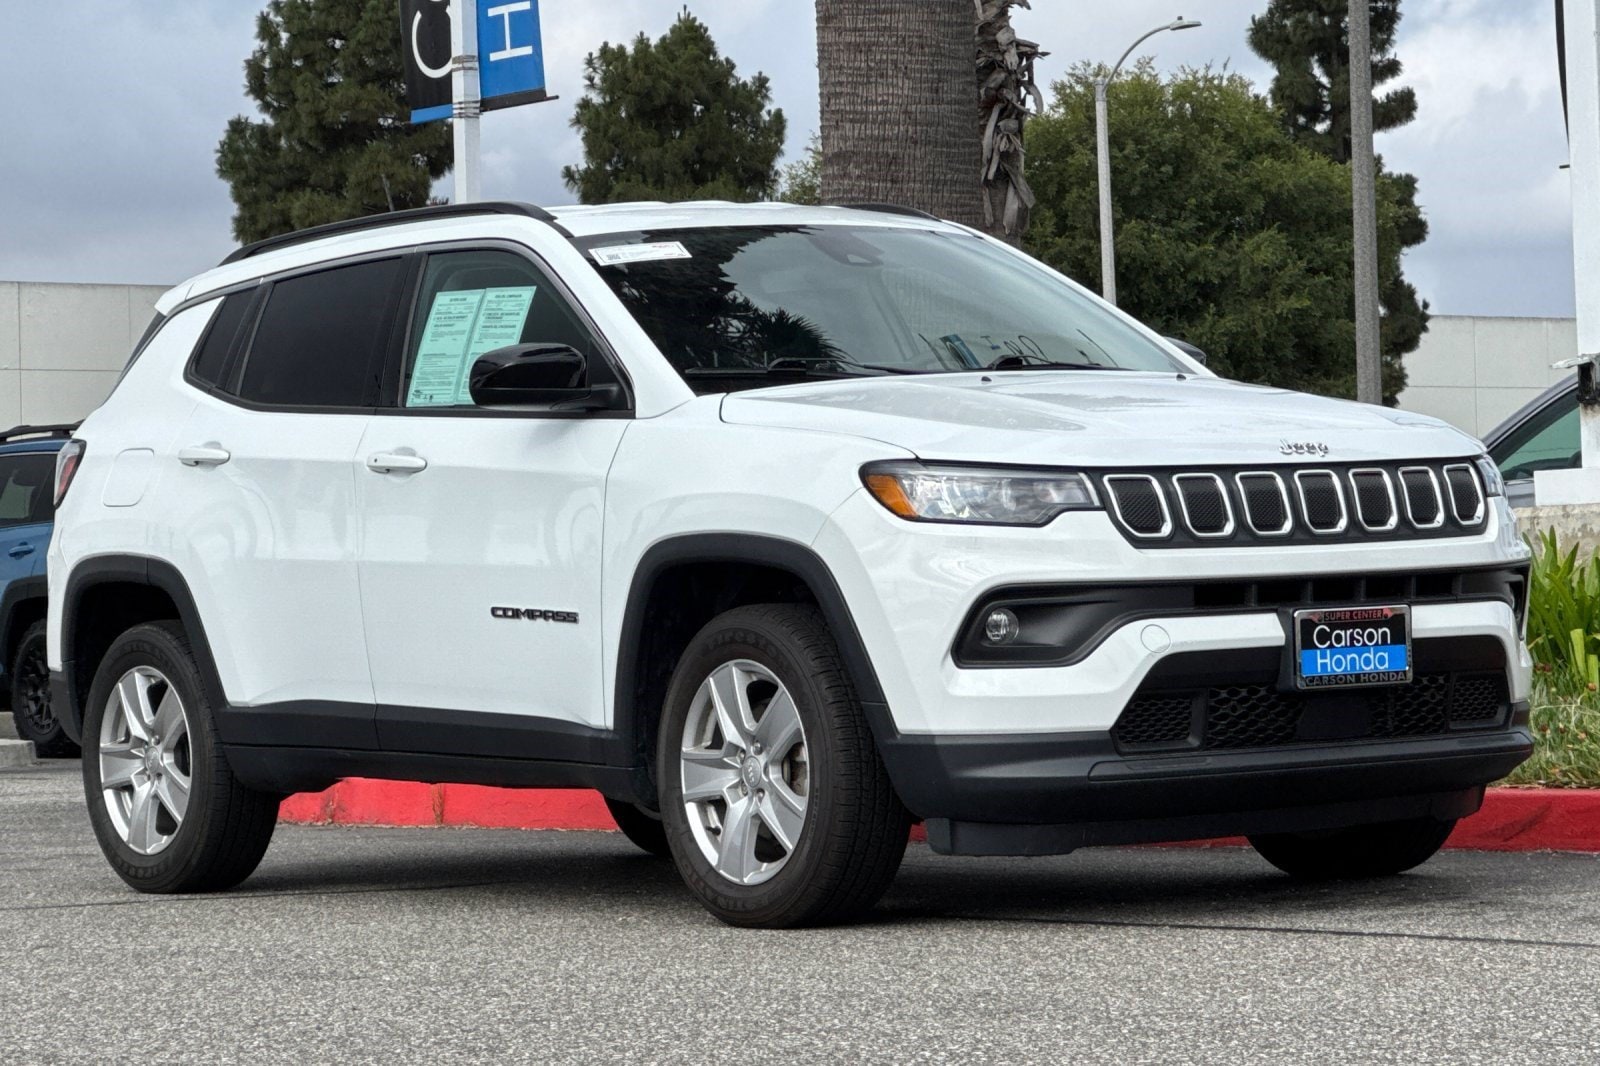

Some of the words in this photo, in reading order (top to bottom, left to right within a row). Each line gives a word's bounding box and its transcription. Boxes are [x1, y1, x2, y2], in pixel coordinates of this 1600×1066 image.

[412, 0, 453, 79] C
[1279, 438, 1329, 458] Jeep
[490, 606, 580, 625] COMPASS
[1324, 610, 1351, 621] SUPER
[1352, 609, 1382, 620] CENTER
[1313, 624, 1391, 649] Carson
[1316, 647, 1389, 673] Honda
[1305, 674, 1357, 686] CARSON
[1360, 671, 1407, 683] HONDA
